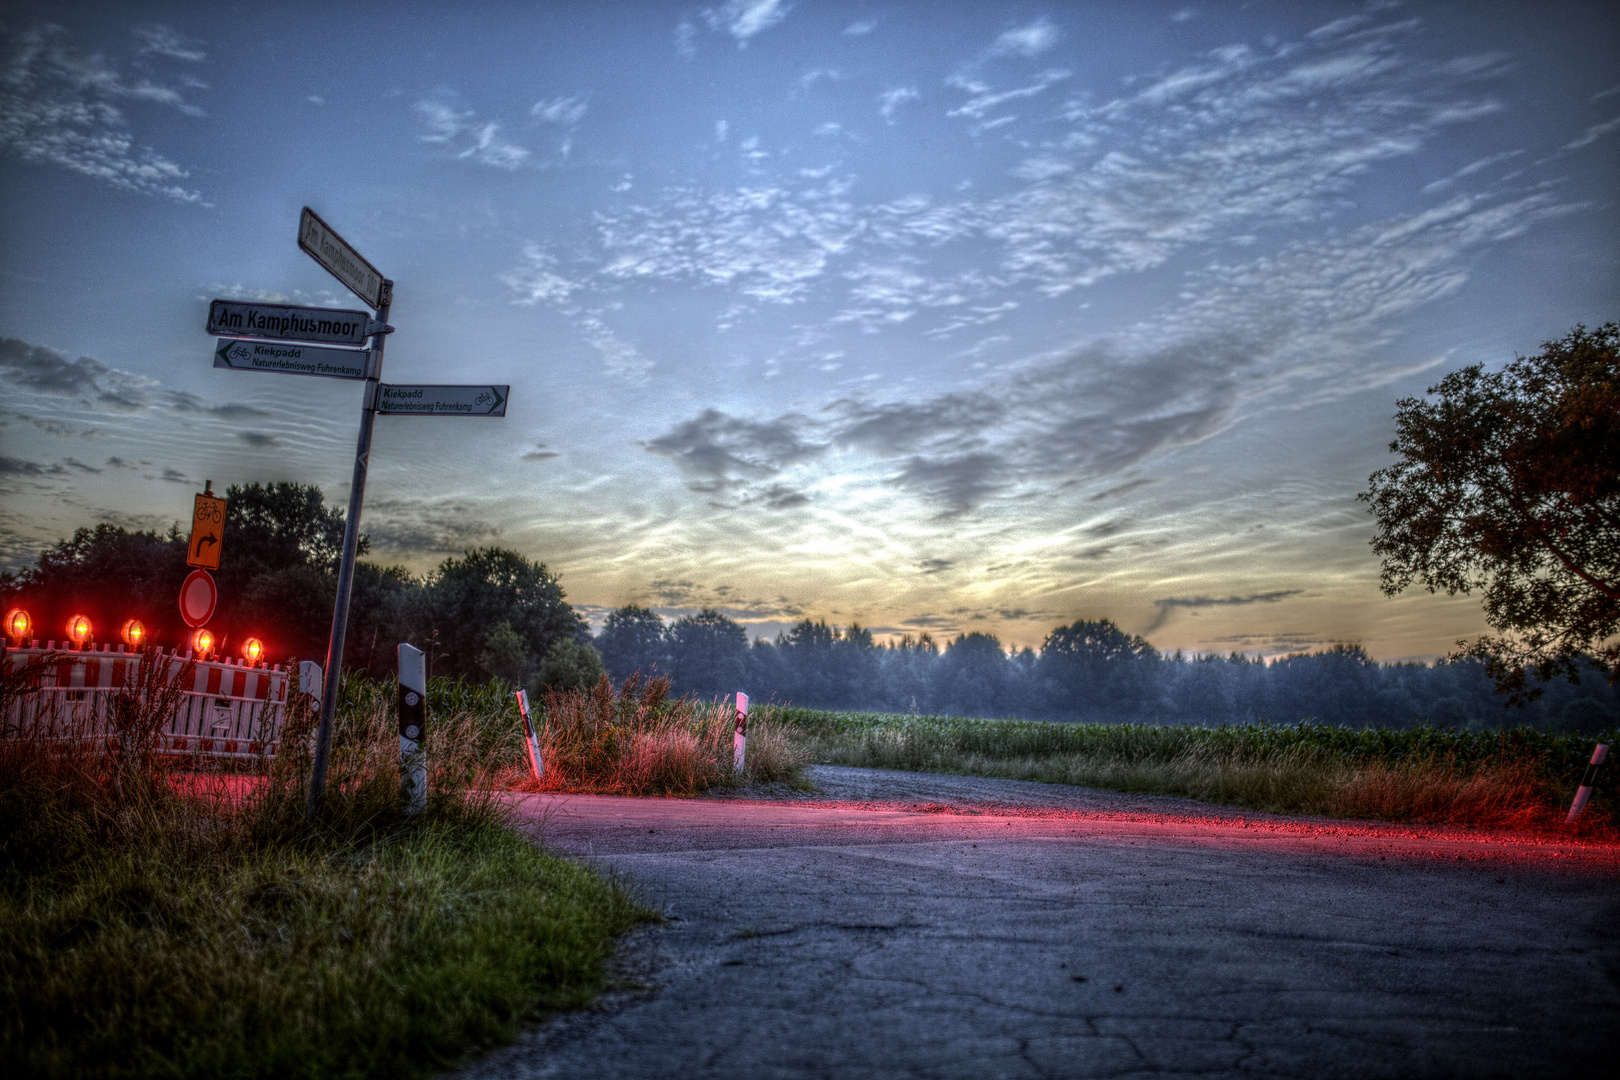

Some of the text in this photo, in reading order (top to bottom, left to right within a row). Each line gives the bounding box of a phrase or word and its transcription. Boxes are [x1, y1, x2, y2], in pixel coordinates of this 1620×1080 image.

[218, 308, 360, 336] Am Kamphusmoor
[254, 346, 301, 359] Kiekpadd
[252, 358, 362, 377] Naturerlebnisweg Fuhrenkamp
[383, 388, 423, 400] Kiekpadd
[381, 401, 473, 412] Naturerlebnisweg Fuhrenkamp
